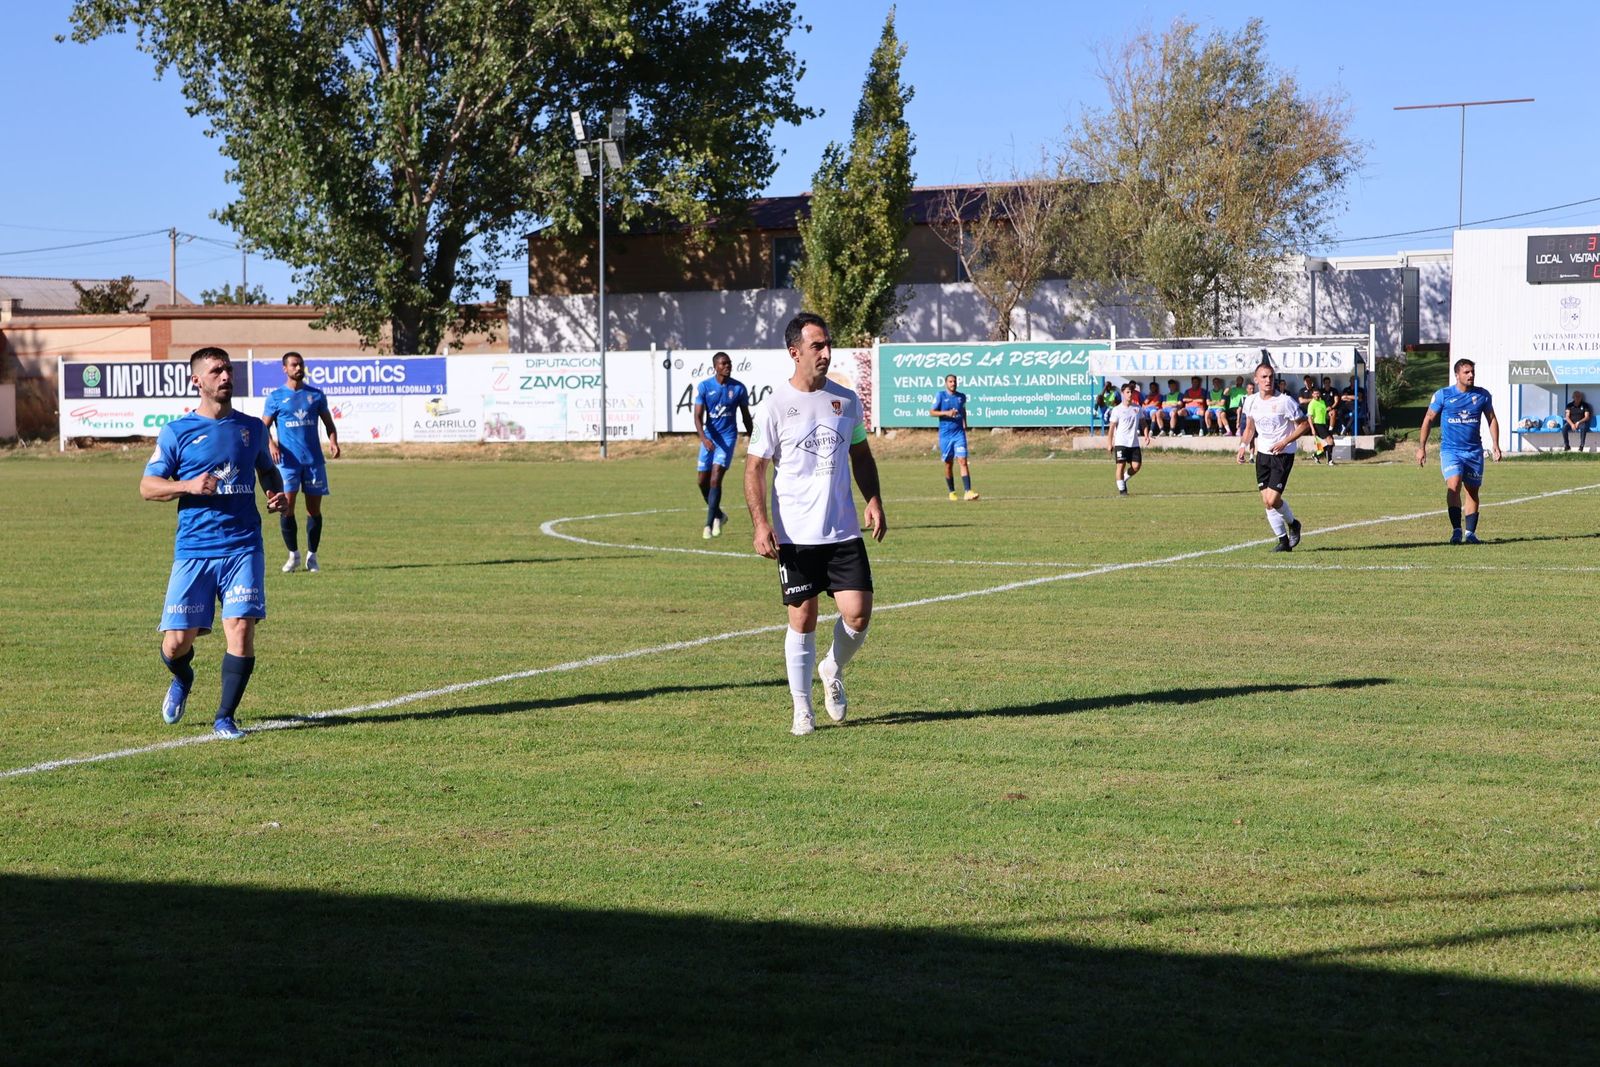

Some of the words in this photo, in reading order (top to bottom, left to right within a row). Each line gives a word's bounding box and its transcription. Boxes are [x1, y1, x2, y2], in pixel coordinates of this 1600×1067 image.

[1535, 254, 1563, 264] LOCAL
[1533, 342, 1600, 351] VILLARALB
[893, 352, 973, 369] VIVEROS
[976, 352, 1002, 367] LA
[1112, 353, 1228, 370] TALLERES
[311, 360, 406, 384] euronics
[1511, 366, 1549, 376] METAL
[519, 375, 608, 390] ZAMORA
[894, 376, 933, 388] VENTA
[936, 376, 946, 388] D
[956, 374, 1011, 387] PLANTAS
[1013, 374, 1022, 386] Y
[1024, 371, 1099, 387] JARDINERÍA
[399, 385, 432, 395] MCDONALD
[893, 409, 913, 418] Ctra.
[976, 408, 982, 417] 3
[985, 407, 1009, 419] (junto
[1010, 407, 1047, 419] rotonda)
[425, 419, 477, 429] CARRILLO
[592, 424, 628, 438] Simpre
[223, 483, 254, 495] RURAL
